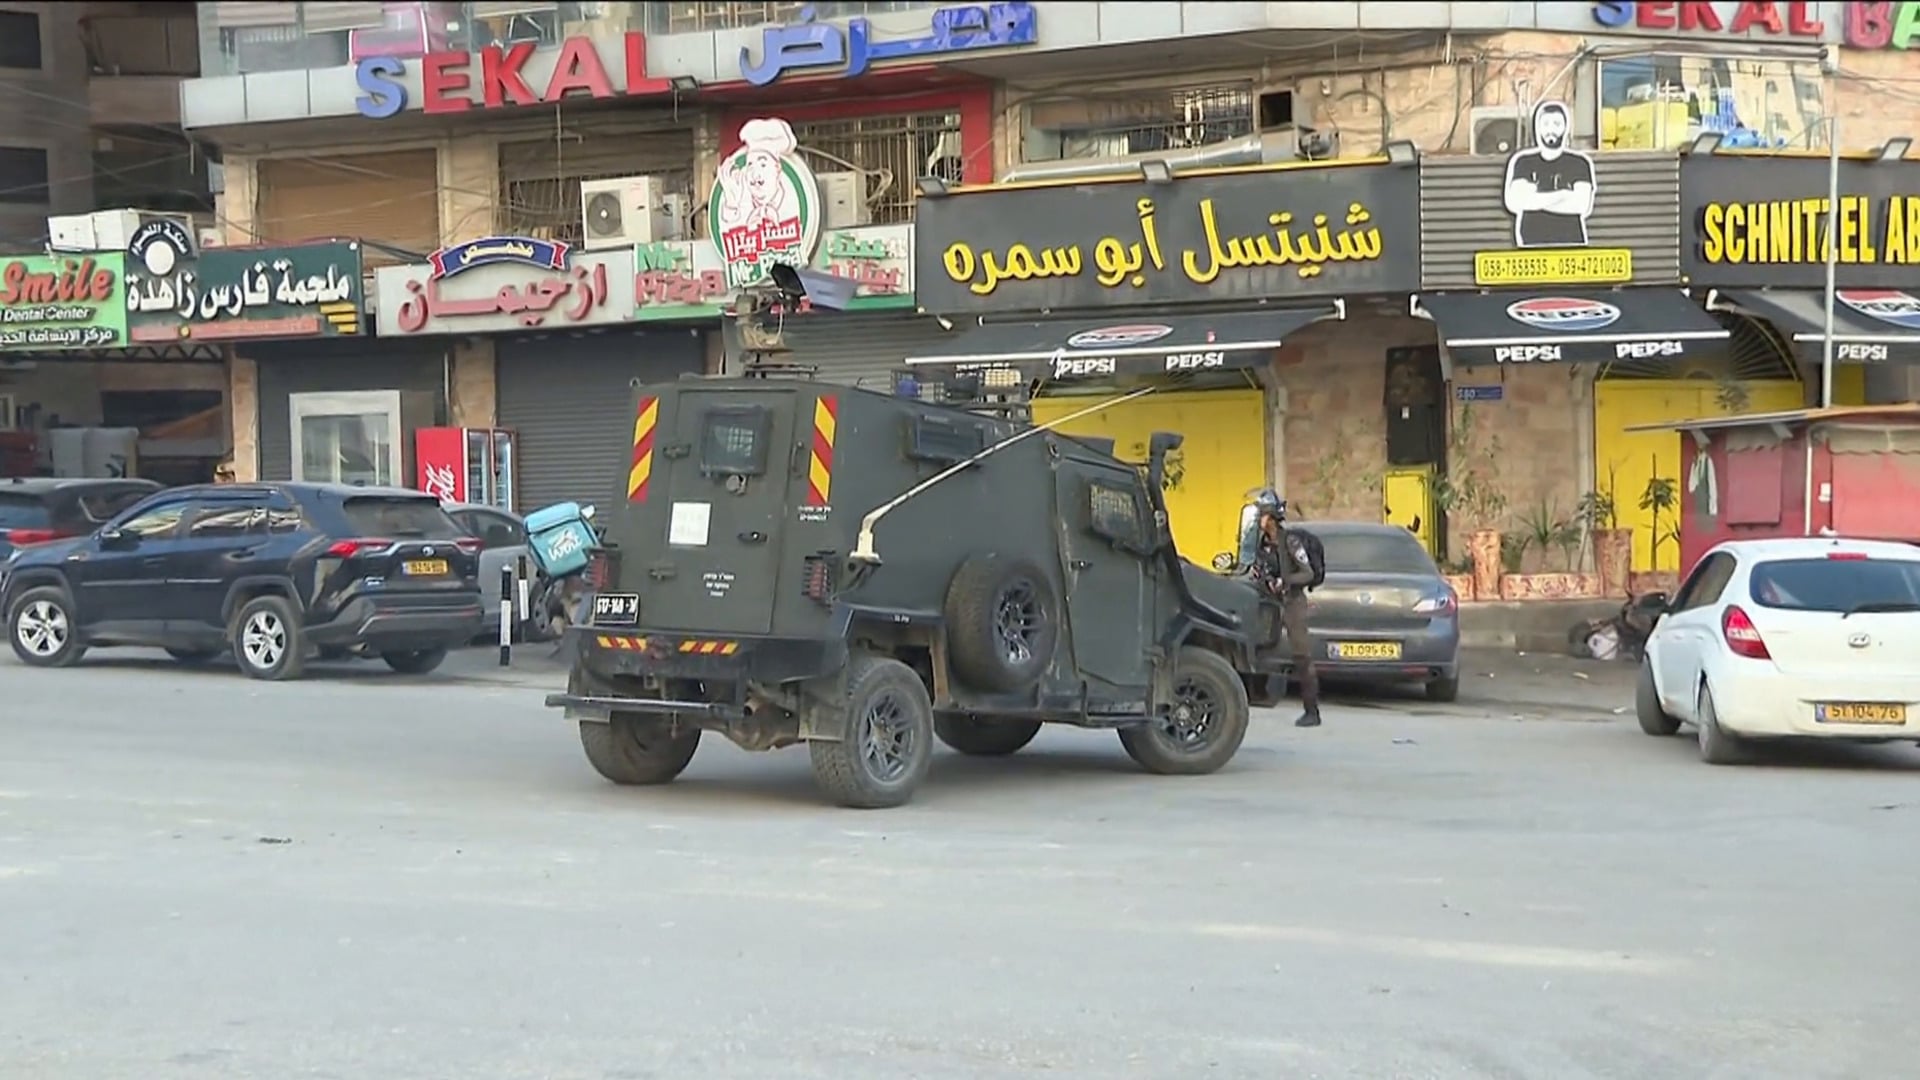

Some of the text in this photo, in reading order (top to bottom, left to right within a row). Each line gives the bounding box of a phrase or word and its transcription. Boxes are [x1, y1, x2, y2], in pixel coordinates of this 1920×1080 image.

[739, 3, 1036, 85] معرض
[355, 31, 671, 119] SEKAL
[943, 197, 1384, 295] شنيتسل أبو سمره
[1558, 256, 1624, 275] 059-4721002
[0, 257, 115, 304] Smile
[125, 259, 351, 319] ملحمة فارس زاهدة
[4, 306, 44, 321] Dental
[45, 306, 89, 320] Center
[82, 327, 113, 345] مركز
[1495, 345, 1562, 362] PEPSI
[1616, 341, 1683, 358] PEPSI
[1838, 344, 1887, 359] PEPSI
[1057, 357, 1116, 376] PEPSI
[1166, 352, 1224, 370] PEPSI
